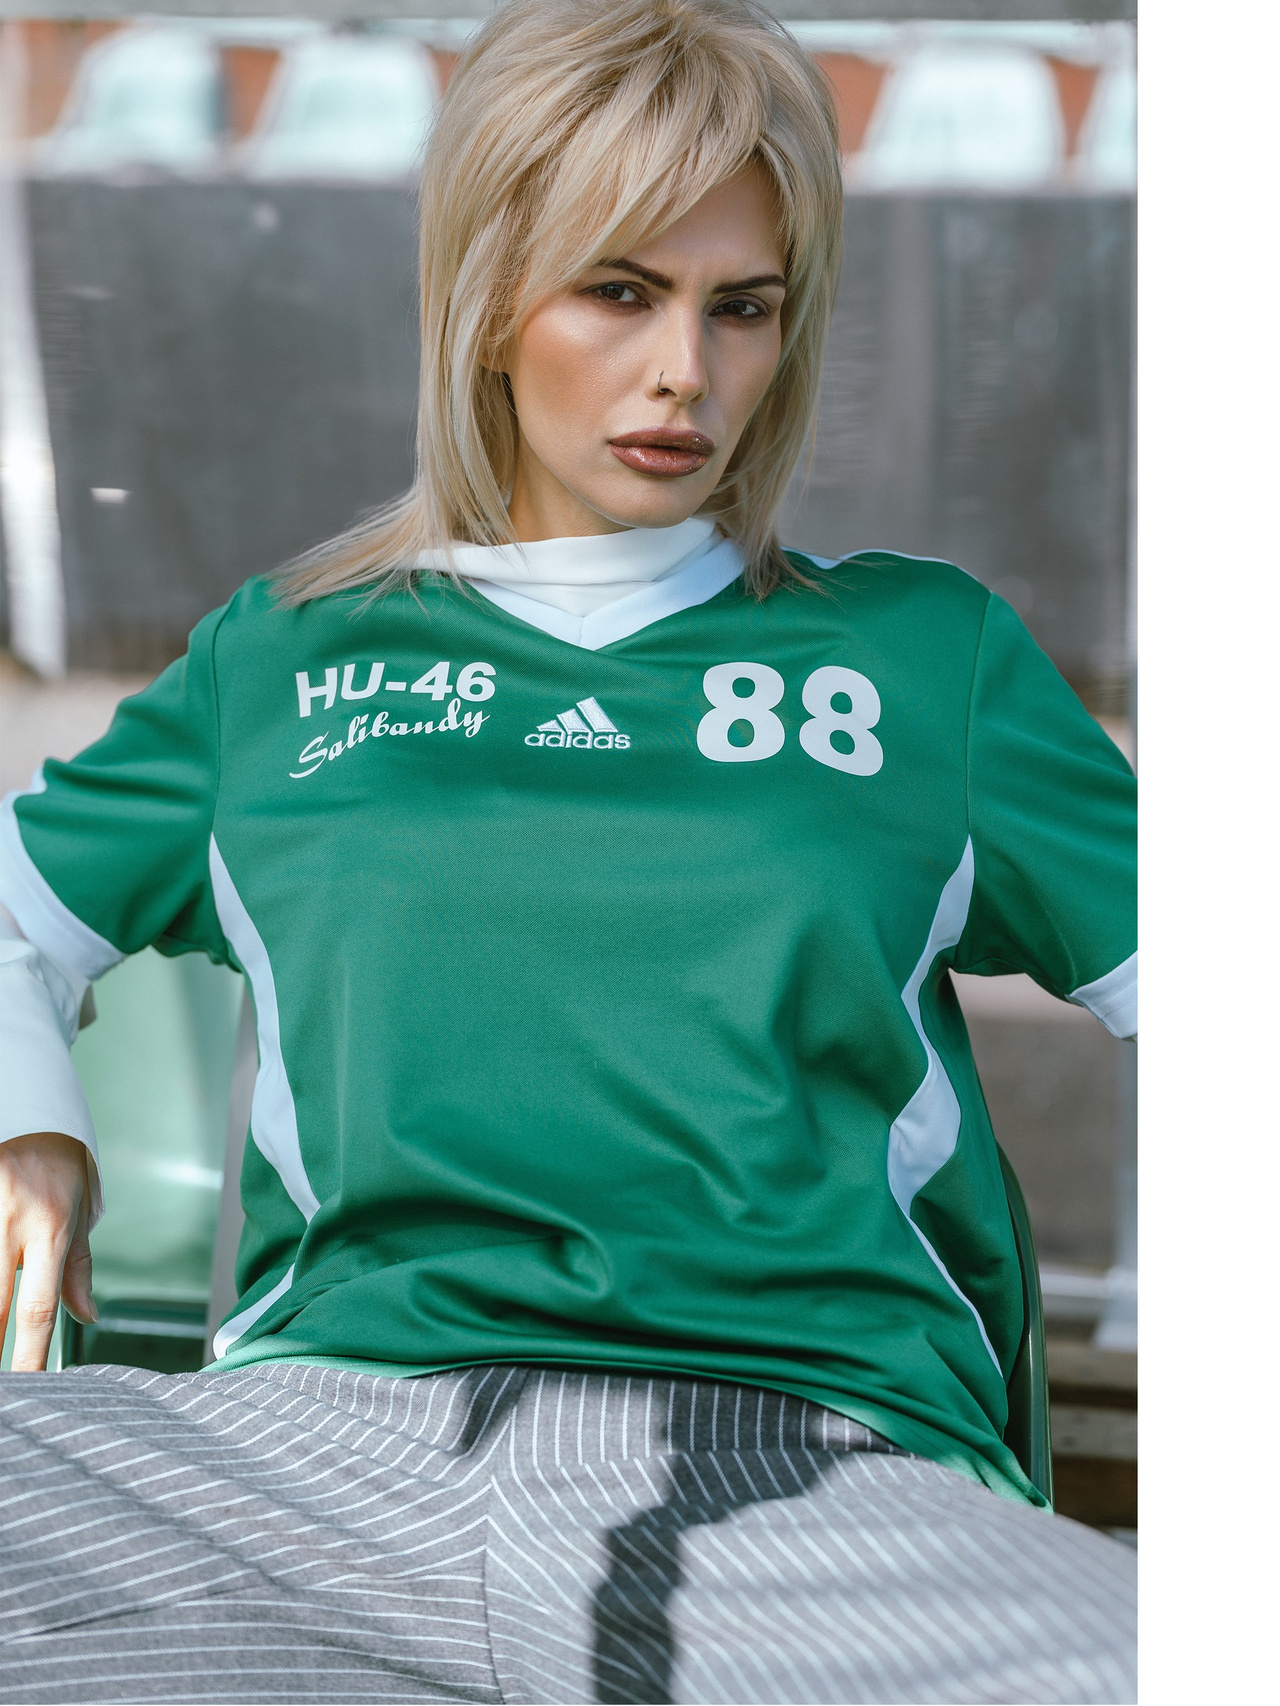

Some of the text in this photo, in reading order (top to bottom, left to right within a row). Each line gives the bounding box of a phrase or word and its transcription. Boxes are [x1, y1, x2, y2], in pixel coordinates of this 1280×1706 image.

[295, 661, 496, 717] HU-46
[698, 662, 884, 777] 88
[289, 698, 490, 778] Salibandy
[524, 729, 631, 749] adidas
